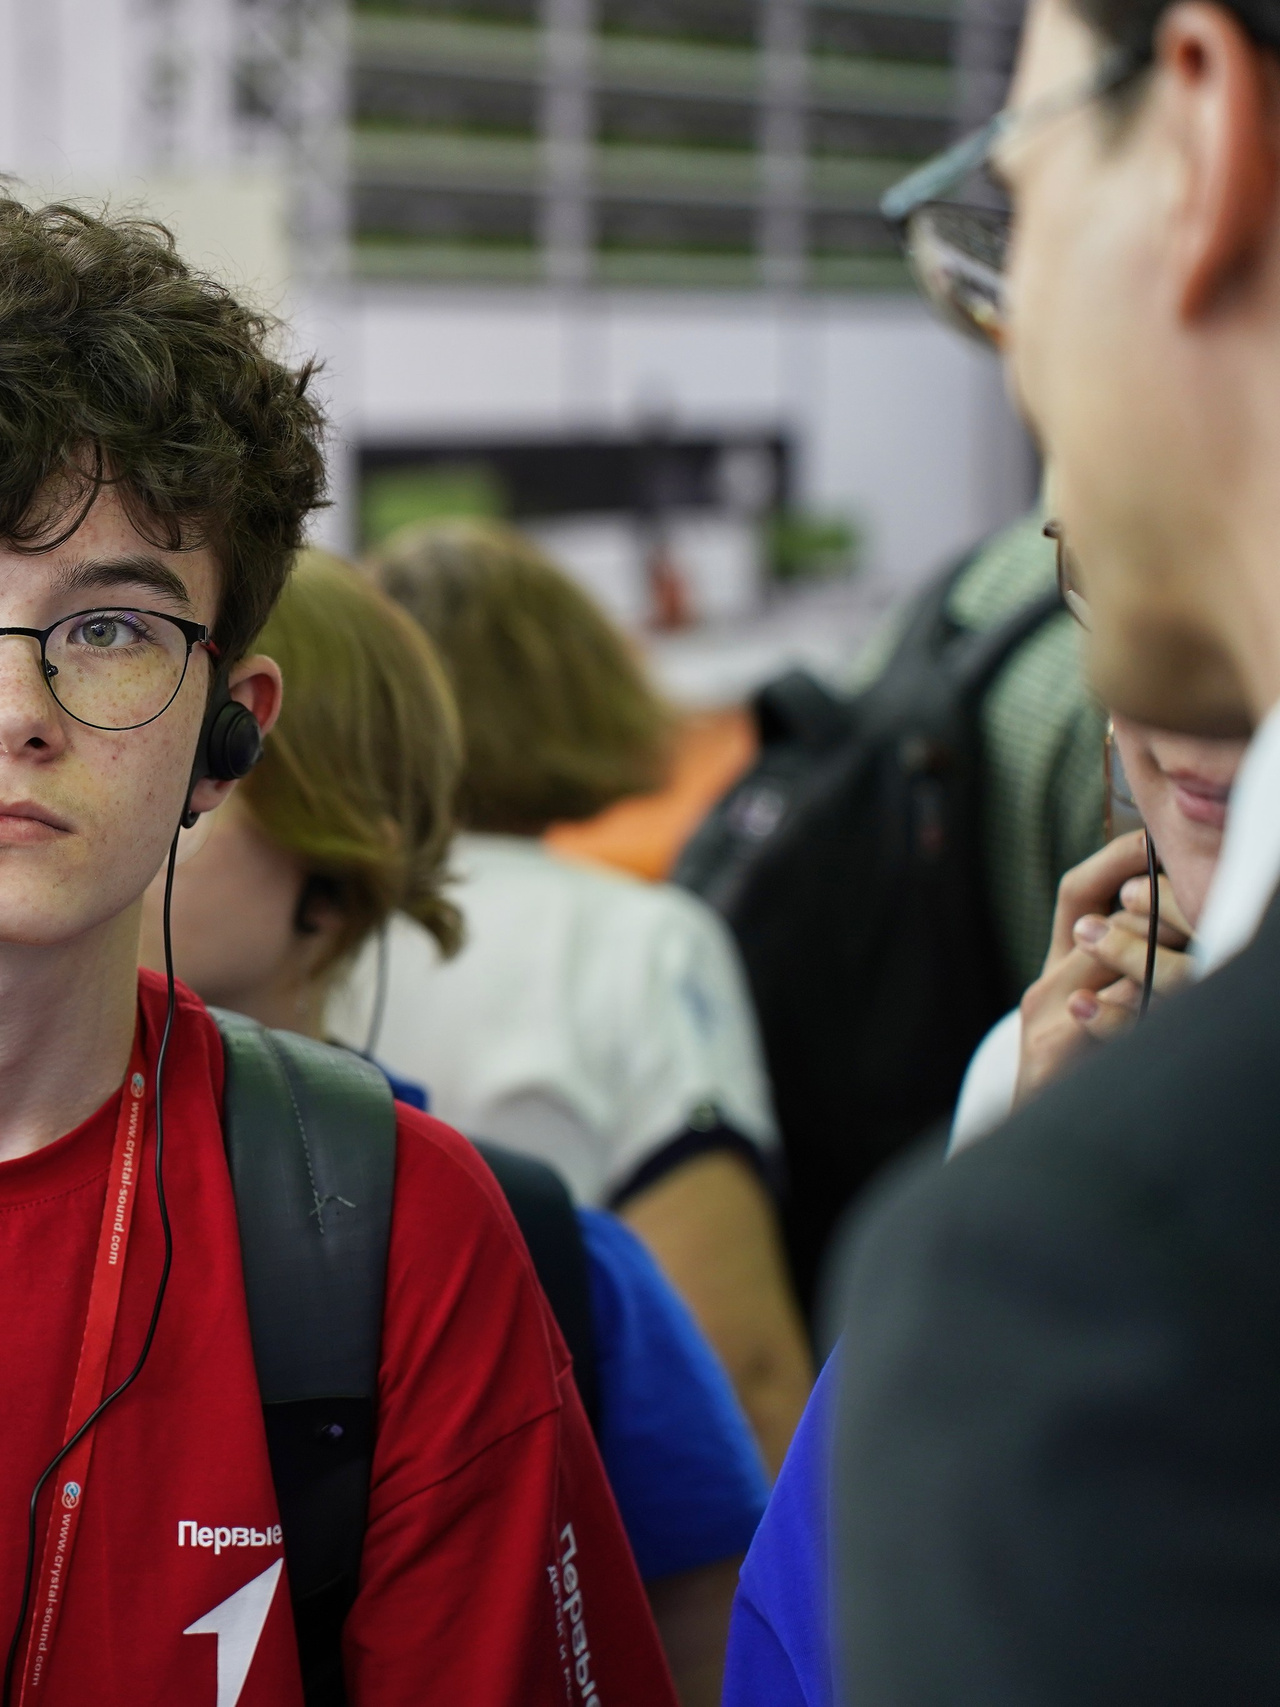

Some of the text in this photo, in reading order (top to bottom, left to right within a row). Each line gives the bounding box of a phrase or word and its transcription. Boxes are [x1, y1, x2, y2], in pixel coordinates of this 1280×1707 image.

[108, 1101, 140, 1265] www.crystal-sound.com
[31, 1513, 72, 1686] www.crystal-sound.com
[177, 1520, 283, 1555] Первые
